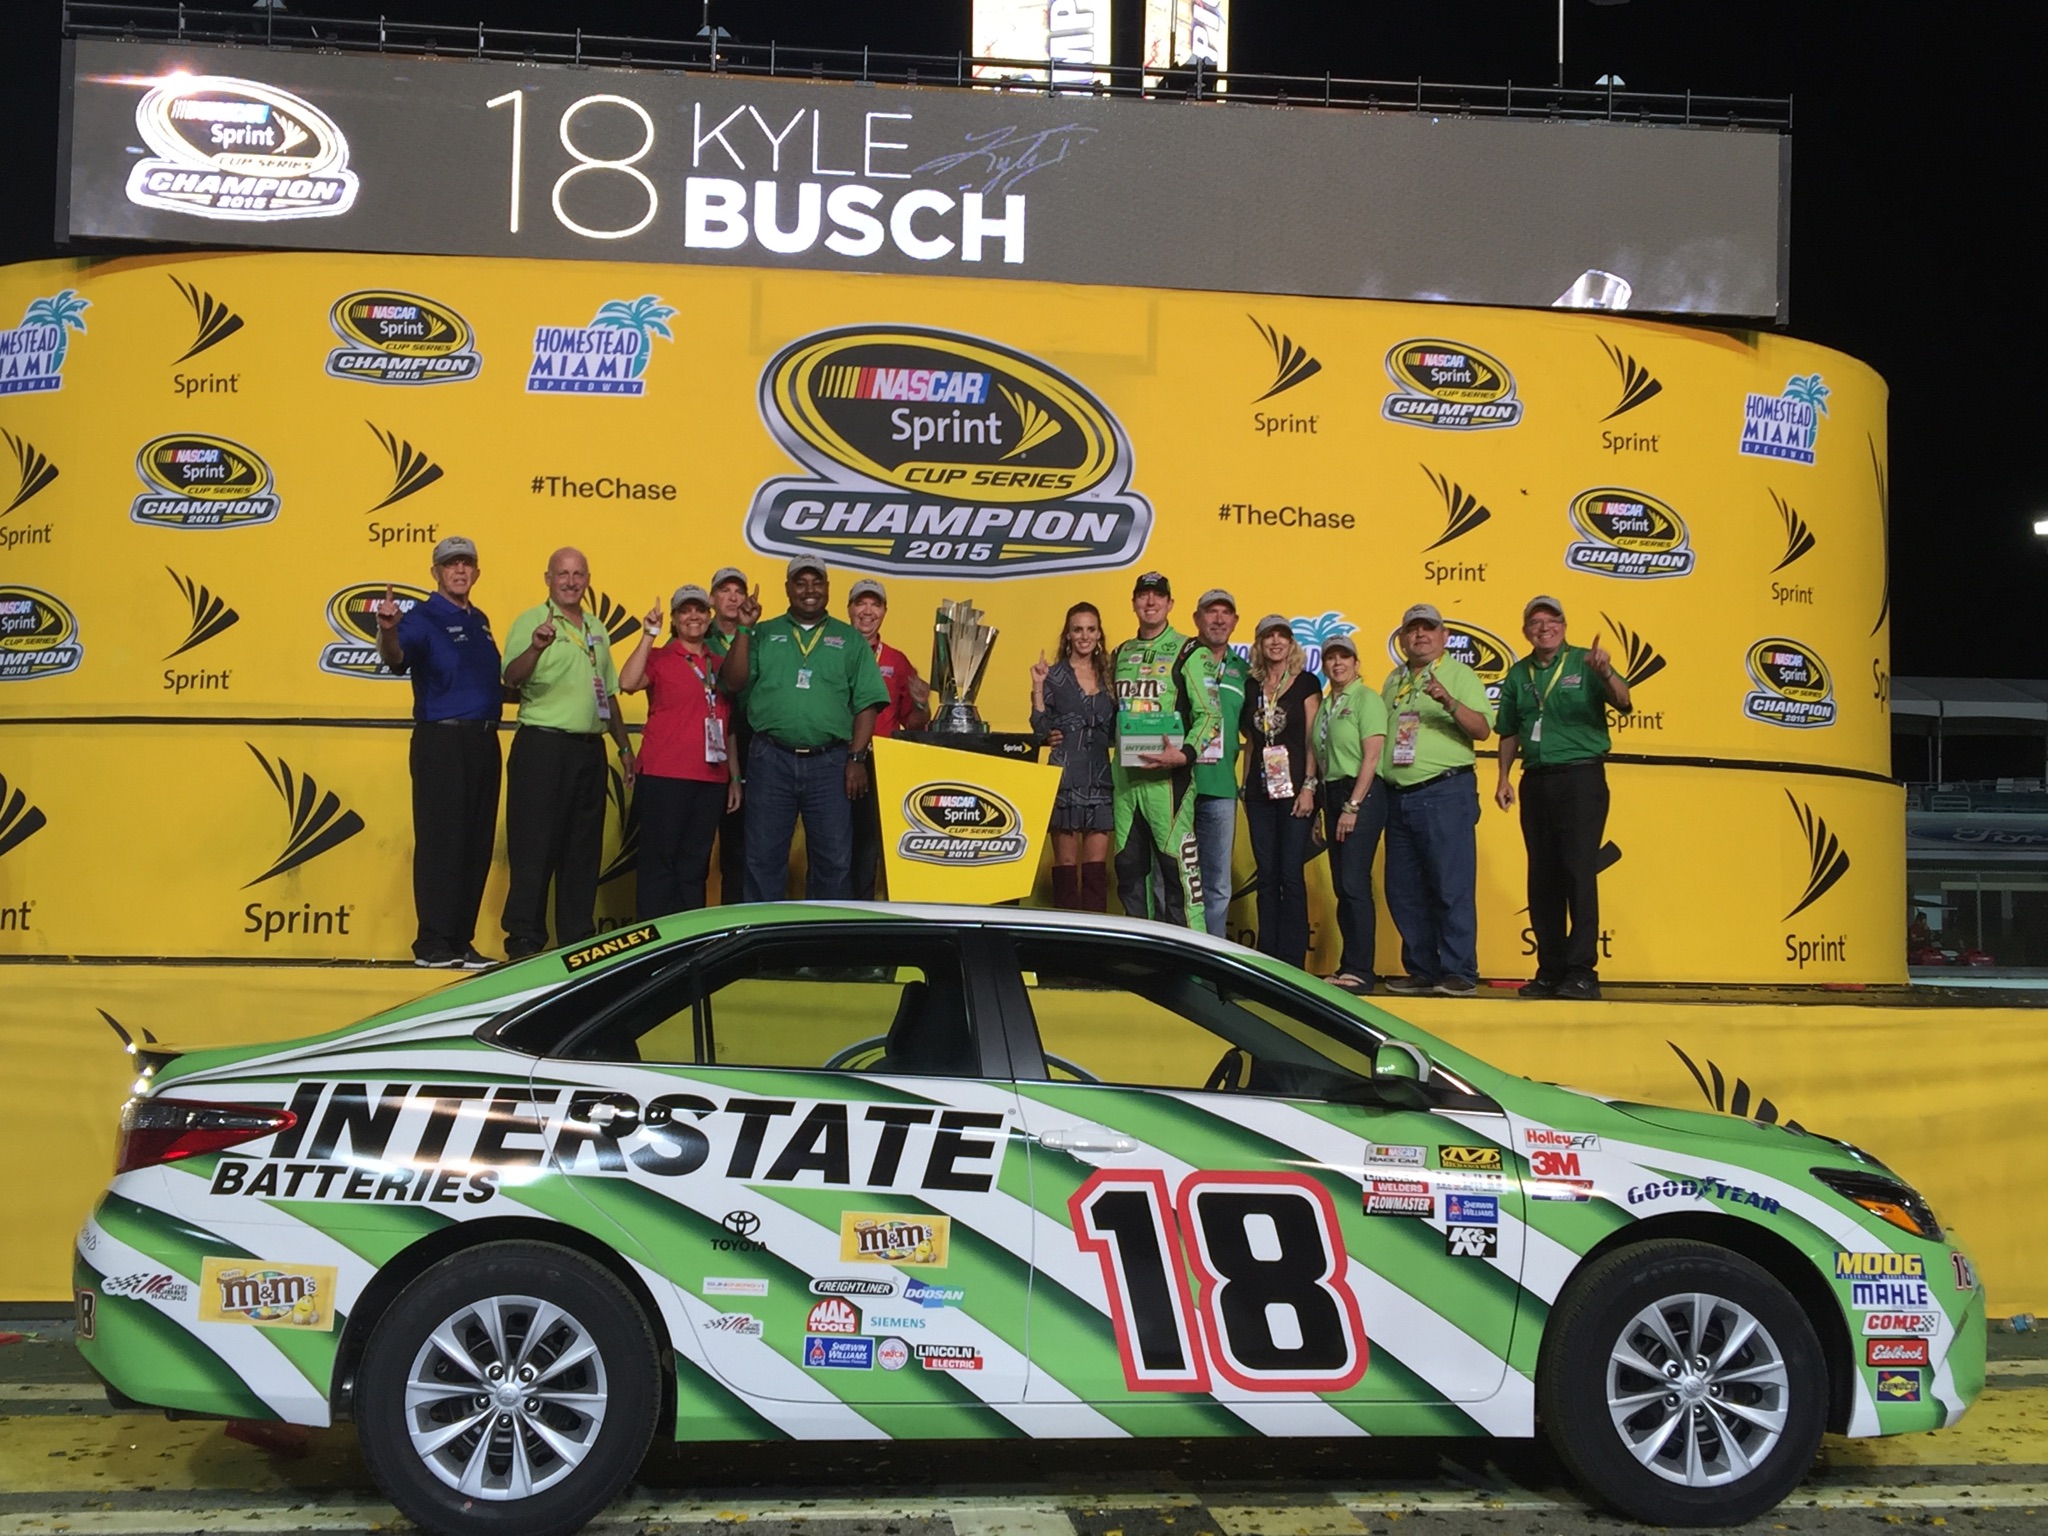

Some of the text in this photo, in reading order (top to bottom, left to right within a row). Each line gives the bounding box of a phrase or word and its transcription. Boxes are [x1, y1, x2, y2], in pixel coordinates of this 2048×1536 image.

[210, 123, 276, 149] Sprint
[693, 101, 913, 179] KYLE
[486, 90, 659, 240] 18
[148, 171, 338, 200] CHAMPION
[216, 196, 268, 210] 2015
[684, 176, 1026, 264] BUSCH
[372, 305, 418, 320] NASCAR
[380, 320, 424, 337] Sprint
[0, 328, 57, 356] MESTEAD
[535, 328, 639, 356] HOMESTEAD
[0, 353, 52, 379] IAMI
[338, 356, 470, 372] CHAMPION
[531, 354, 633, 379] MIAMI
[1424, 354, 1465, 368] NASCAR
[386, 371, 420, 379] 2015
[1431, 367, 1472, 384] Sprint
[174, 373, 238, 399] Sprint
[533, 379, 639, 393] SPEEDWAY
[870, 367, 985, 405] NASCAR
[1393, 401, 1513, 418] CHAMPION
[1746, 394, 1812, 427] HOMESTEAD
[890, 408, 1003, 451] Sprint
[1254, 412, 1318, 437] Sprint
[1437, 416, 1469, 425] 2015
[1602, 431, 1658, 455] Sprint
[1743, 419, 1808, 448] MIAMI
[175, 449, 219, 463] NASCAR
[183, 464, 225, 481] Sprint
[531, 475, 677, 501] #TheChase
[142, 500, 269, 515] CHAMPION
[1218, 503, 1356, 529] #TheChase
[187, 514, 219, 524] 2015
[780, 500, 1120, 543] CHAMPION
[1611, 516, 1649, 533] Sprint
[0, 525, 51, 551] Sprint
[368, 522, 437, 547] Sprint
[904, 541, 993, 562] 2015
[1576, 549, 1686, 567] CHAMPION
[1424, 561, 1486, 585] Sprint
[1771, 582, 1814, 605] Sprint
[1, 615, 36, 633] Sprint
[0, 651, 72, 665] MPION
[163, 669, 230, 695] Sprint
[1779, 667, 1807, 682] Sprint
[1752, 698, 1832, 718] CHAMPION
[1606, 709, 1664, 734] Sprint
[938, 795, 977, 808] NASCAR
[944, 808, 980, 823] Sprint
[909, 838, 1017, 852] CHAMPION
[244, 902, 350, 942] Sprint
[568, 927, 651, 968] STANLEY
[1785, 934, 1846, 969] Sprint
[268, 1082, 1005, 1194] INTERSTATE
[1526, 1129, 1572, 1149] Holley
[1531, 1150, 1581, 1176] 3M
[209, 1161, 498, 1205] BATTERIES
[1377, 1182, 1424, 1193] WELDERS
[1366, 1195, 1431, 1213] FLOWMASTER
[1627, 1178, 1781, 1215] GOODYEAR
[711, 1239, 767, 1253] TOYOTA
[1837, 1252, 1922, 1275] MOOG
[816, 1281, 891, 1294] FREIGHTLINER
[1078, 1179, 1360, 1381] 18
[905, 1288, 964, 1300] DOOSAN
[1853, 1283, 1929, 1305] MAHLE
[810, 1322, 855, 1333] TOOLS
[870, 1316, 926, 1329] SIEMENS
[1867, 1314, 1922, 1330] COMP
[828, 1350, 868, 1360] WILLIAMS
[918, 1345, 973, 1358] LINCOLN
[1872, 1344, 1924, 1360] Edelbrock
[932, 1359, 976, 1369] ELECTRIC
[1879, 1382, 1919, 1392] SUNOCO
